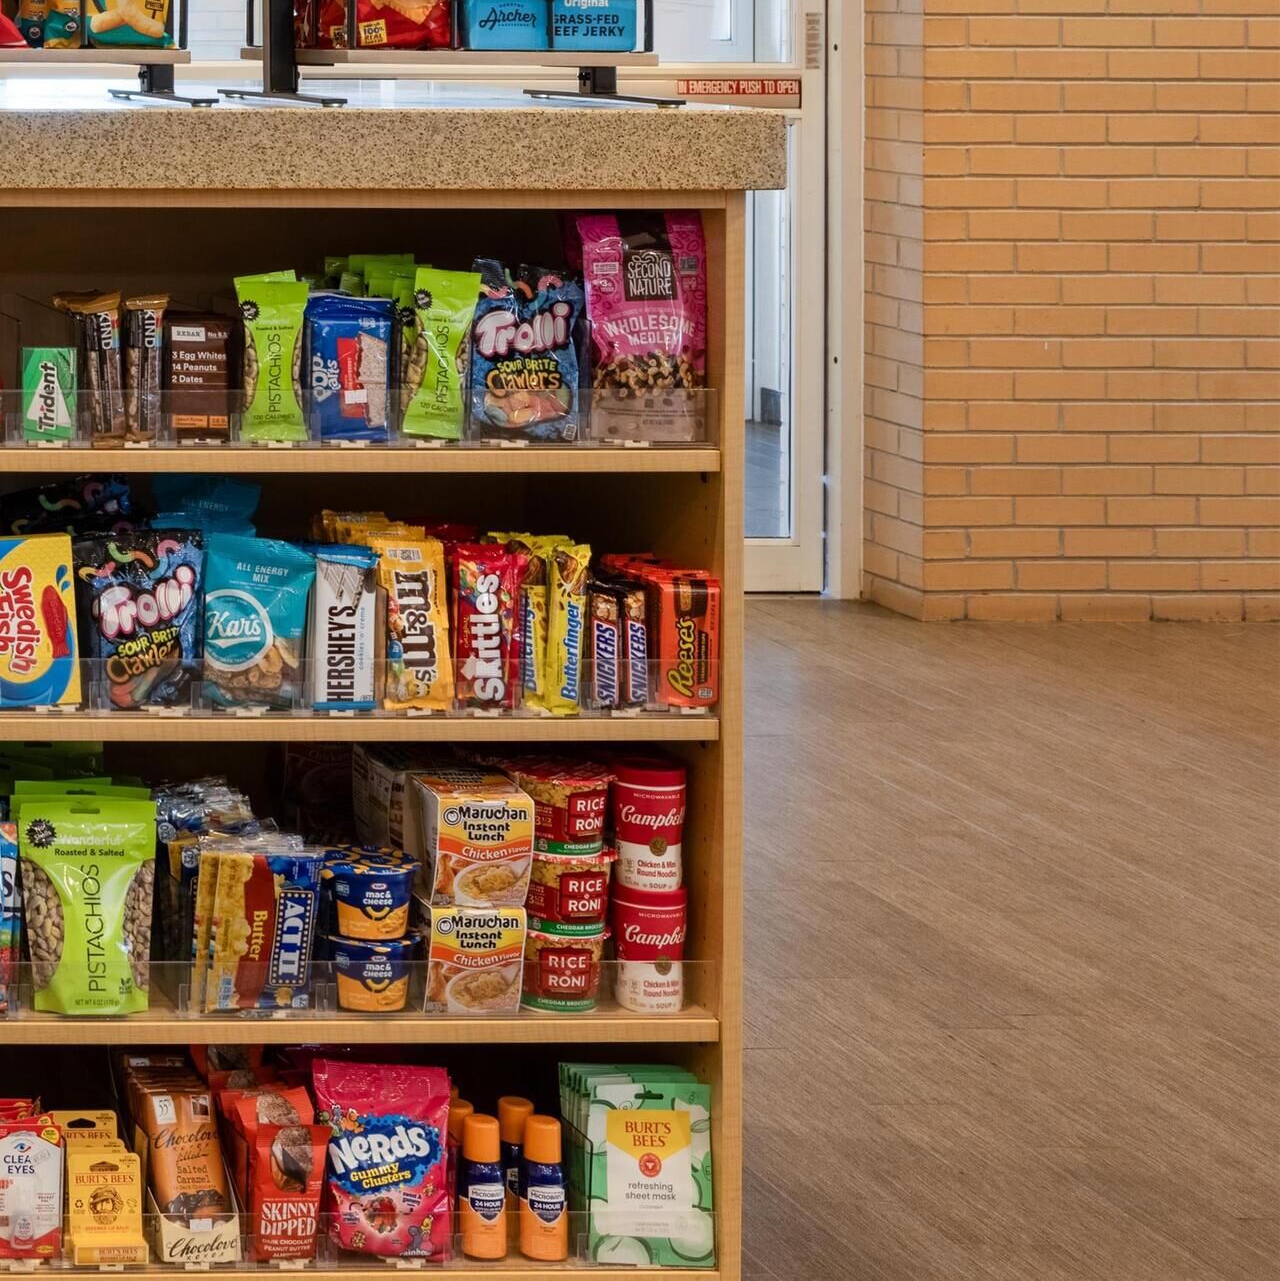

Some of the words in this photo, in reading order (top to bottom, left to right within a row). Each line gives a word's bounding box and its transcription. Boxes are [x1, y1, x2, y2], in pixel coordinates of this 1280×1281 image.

[478, 6, 537, 30] Archer
[678, 81, 687, 94] IN
[688, 81, 738, 95] EMERGENCY
[740, 81, 761, 94] PUSH
[763, 81, 775, 94] TO
[777, 81, 799, 94] OPEN
[627, 261, 672, 280] SECOND
[628, 277, 673, 297] NATURE
[144, 309, 156, 349] KIND
[476, 302, 572, 357] Trolli
[603, 315, 695, 338] WHOLESOME
[172, 351, 178, 361] 3
[180, 350, 196, 362] Egg
[198, 350, 226, 361] Whites
[171, 363, 181, 371] 14
[183, 363, 217, 372] Peanuts
[268, 333, 282, 413] PISTACHIOS
[171, 374, 178, 383] 2
[180, 374, 203, 383] Dates
[486, 370, 562, 398] Crawlers
[37, 362, 57, 433] Trident
[236, 562, 252, 572] ALL
[255, 564, 289, 577] ENERGY
[252, 573, 270, 584] MIX
[100, 565, 194, 639] Trolli
[0, 566, 40, 675] Swedish
[473, 573, 506, 702] Skittles
[326, 605, 357, 702] HERSHEY'S
[560, 601, 583, 702] Butterfinger
[667, 614, 696, 699] Reese's
[594, 620, 617, 706] SNICKERS
[629, 622, 647, 703] SNICKERS
[458, 806, 528, 821] Maruchan
[576, 798, 606, 811] RICE
[463, 821, 511, 833] Instant
[575, 817, 603, 832] RONI
[467, 831, 505, 842] Lunch
[54, 848, 88, 857] Roasted
[89, 849, 96, 857] &
[98, 848, 125, 858] Salted
[82, 863, 107, 993] PISTACHIOS
[248, 909, 269, 961] Butter
[625, 1121, 672, 1135] BURT'S
[632, 1135, 667, 1148] BEES
[7, 1164, 36, 1175] EYES
[75, 1173, 107, 1184] BURT'S
[110, 1174, 135, 1183] BEES
[349, 1162, 400, 1182] Gummy
[361, 1170, 412, 1189] Clusters
[627, 1181, 674, 1192] refreshing
[625, 1191, 649, 1201] sheet
[651, 1191, 677, 1201] mask
[261, 1202, 319, 1221] SKINNY
[260, 1219, 317, 1237] DIPPED
[169, 1234, 237, 1259] Chocolove
